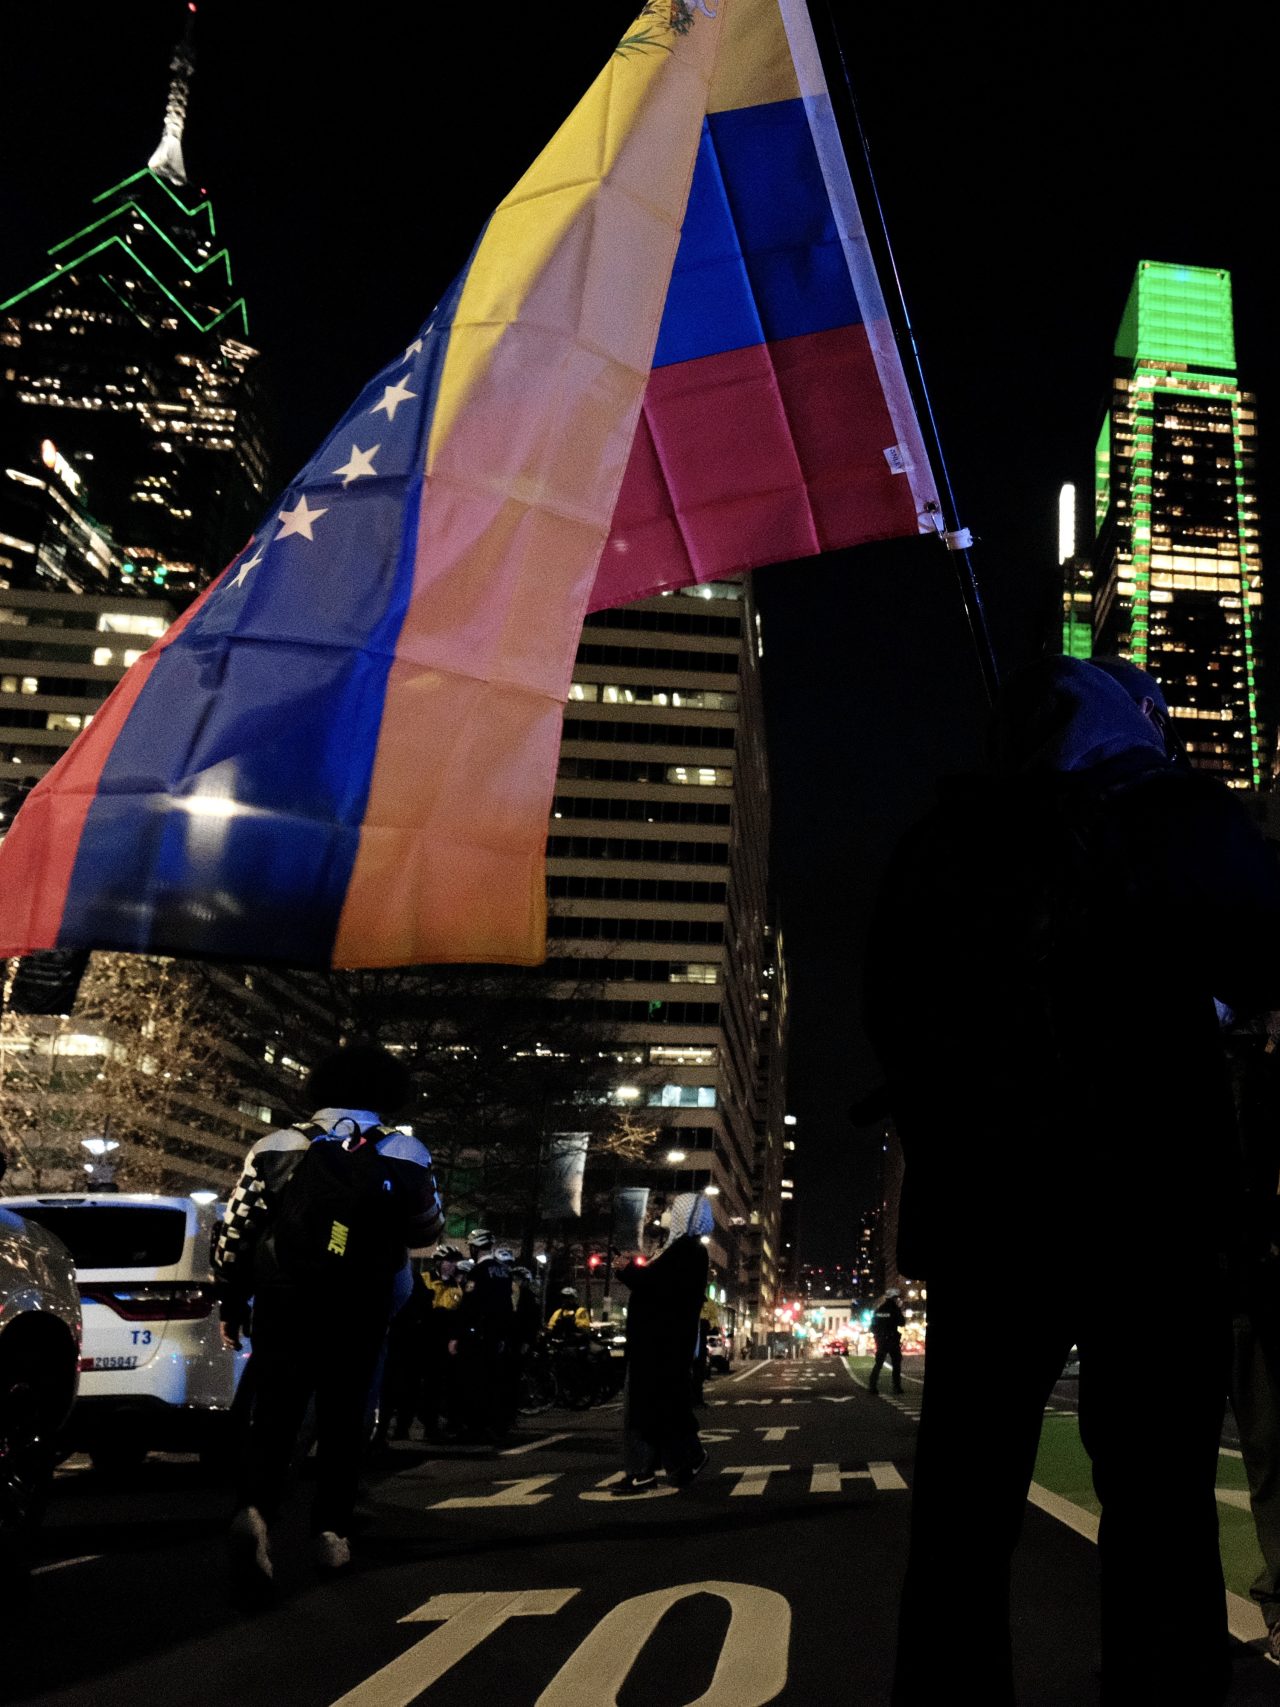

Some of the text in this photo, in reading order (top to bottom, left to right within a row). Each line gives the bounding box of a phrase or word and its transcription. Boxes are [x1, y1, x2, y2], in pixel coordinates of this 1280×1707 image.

[328, 1220, 350, 1256] NIKE
[131, 1330, 151, 1345] T3
[697, 1425, 801, 1443] ST
[328, 1580, 792, 1707] TO
